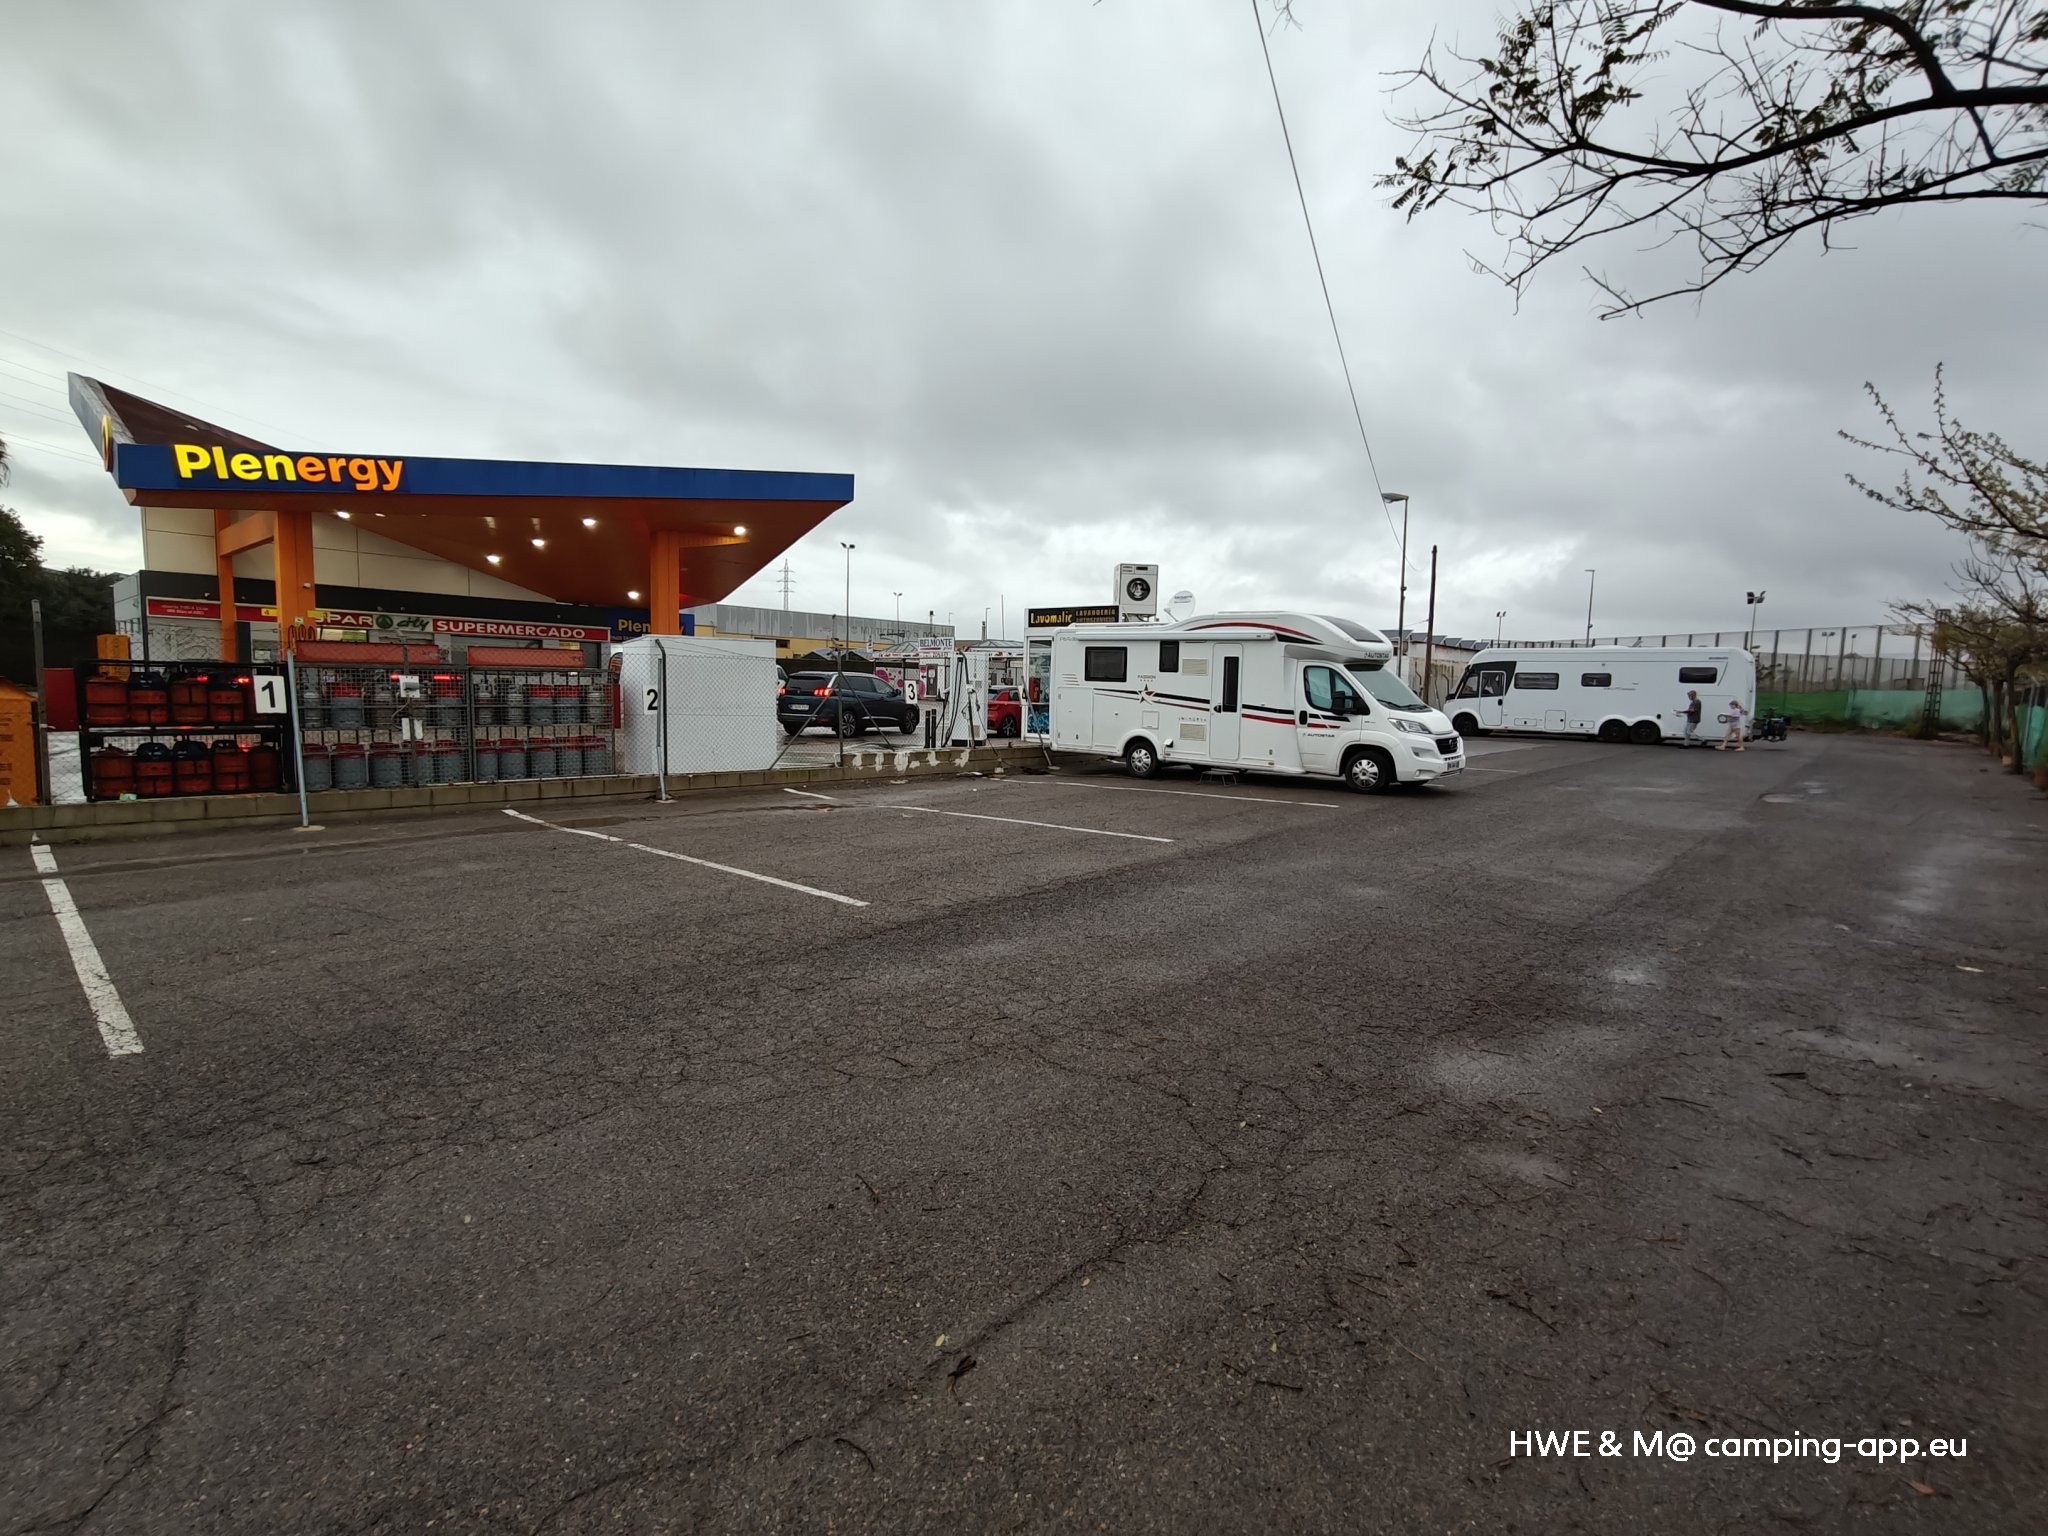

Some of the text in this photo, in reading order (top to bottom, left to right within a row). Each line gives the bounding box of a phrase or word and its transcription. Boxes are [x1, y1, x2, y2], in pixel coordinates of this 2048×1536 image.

[174, 444, 403, 491] Plenergy
[436, 620, 585, 639] SUPERMERCADO
[919, 638, 953, 648] BELMONTE
[261, 680, 276, 708] 1
[646, 688, 659, 712] 2
[907, 683, 916, 700] 3
